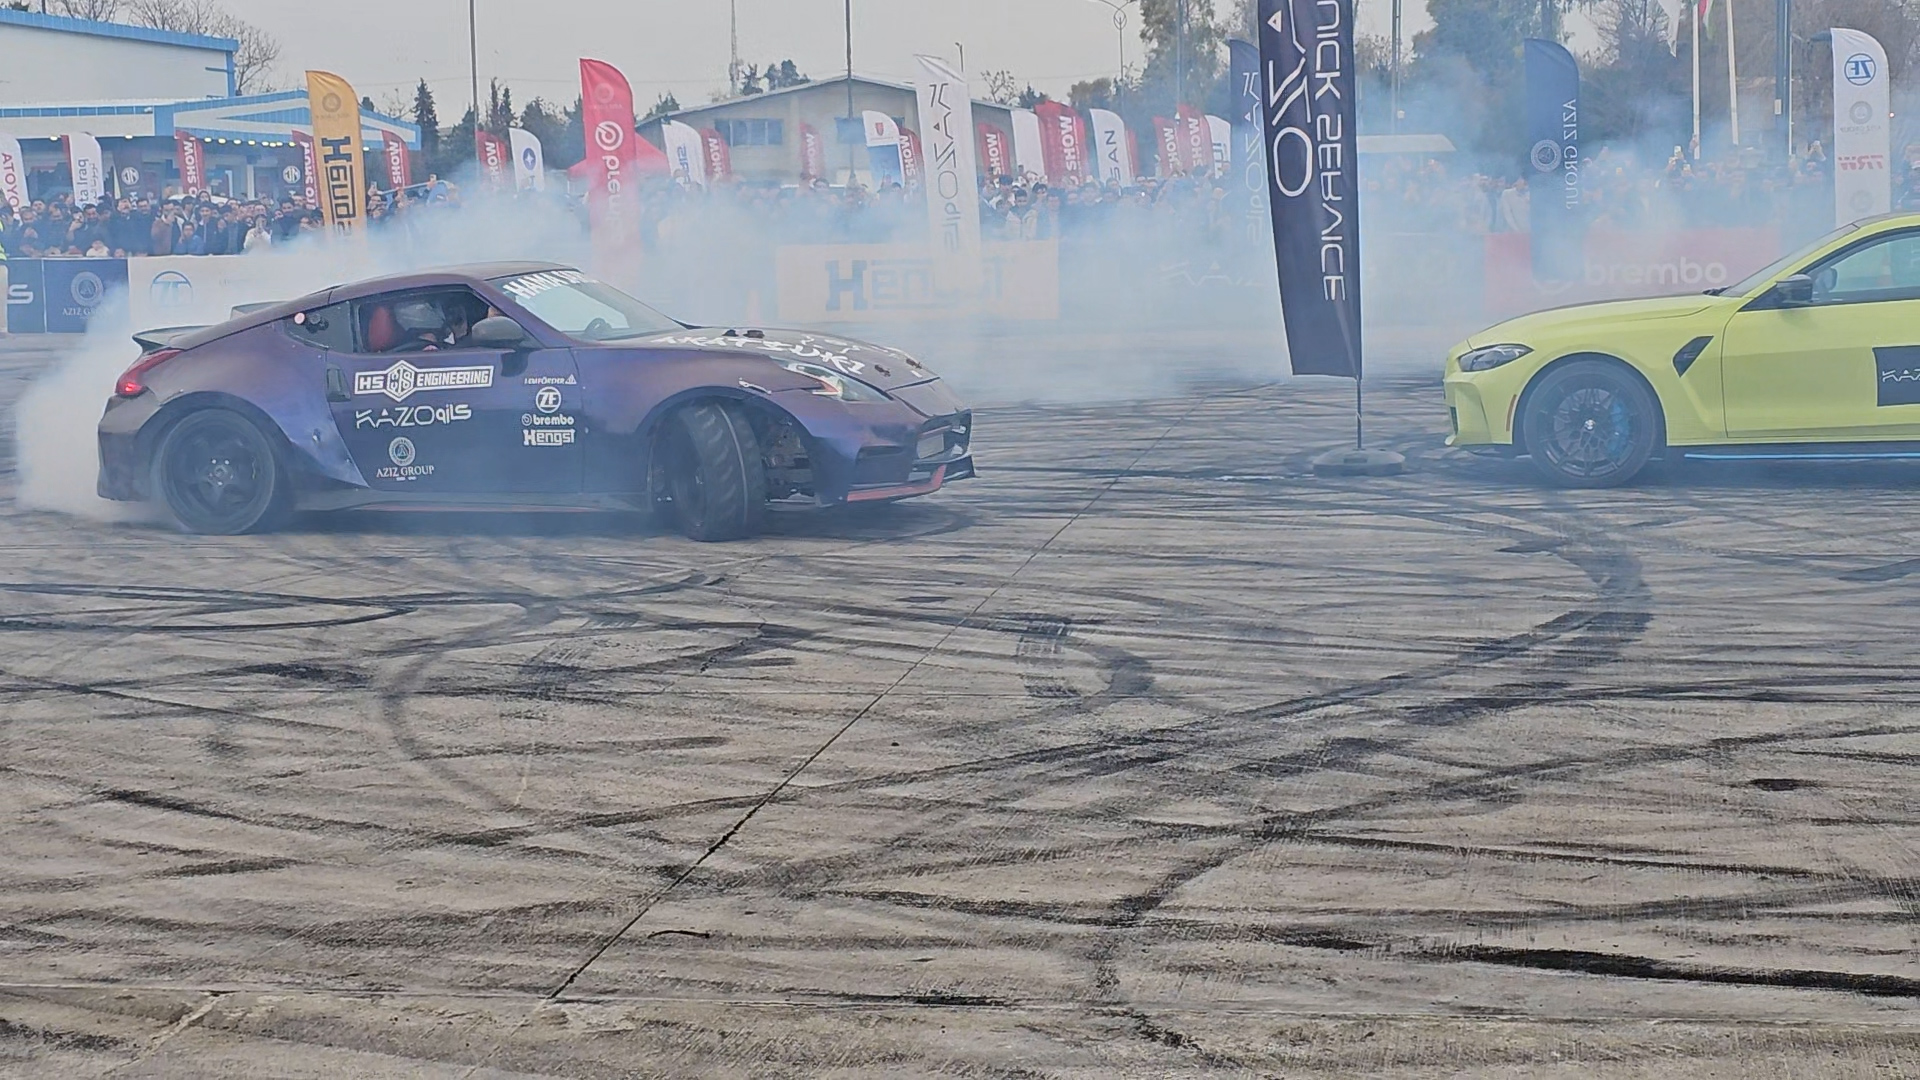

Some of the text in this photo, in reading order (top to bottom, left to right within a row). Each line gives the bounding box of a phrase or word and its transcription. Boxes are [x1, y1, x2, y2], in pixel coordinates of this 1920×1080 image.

[899, 134, 916, 177] SHOW
[985, 132, 1002, 176] SHOW
[1058, 114, 1078, 171] SHOW
[76, 157, 90, 185] Iraq
[182, 139, 197, 184] SHOW
[388, 140, 402, 188] SHOW
[1584, 256, 1728, 286] brembo
[359, 369, 490, 390] HS ENGINEERING
[1882, 368, 1920, 383] KA
[538, 390, 560, 409] ZF
[532, 413, 575, 426] brembo
[522, 428, 576, 446] Hengst
[376, 464, 435, 478] AZIZ GROUP
